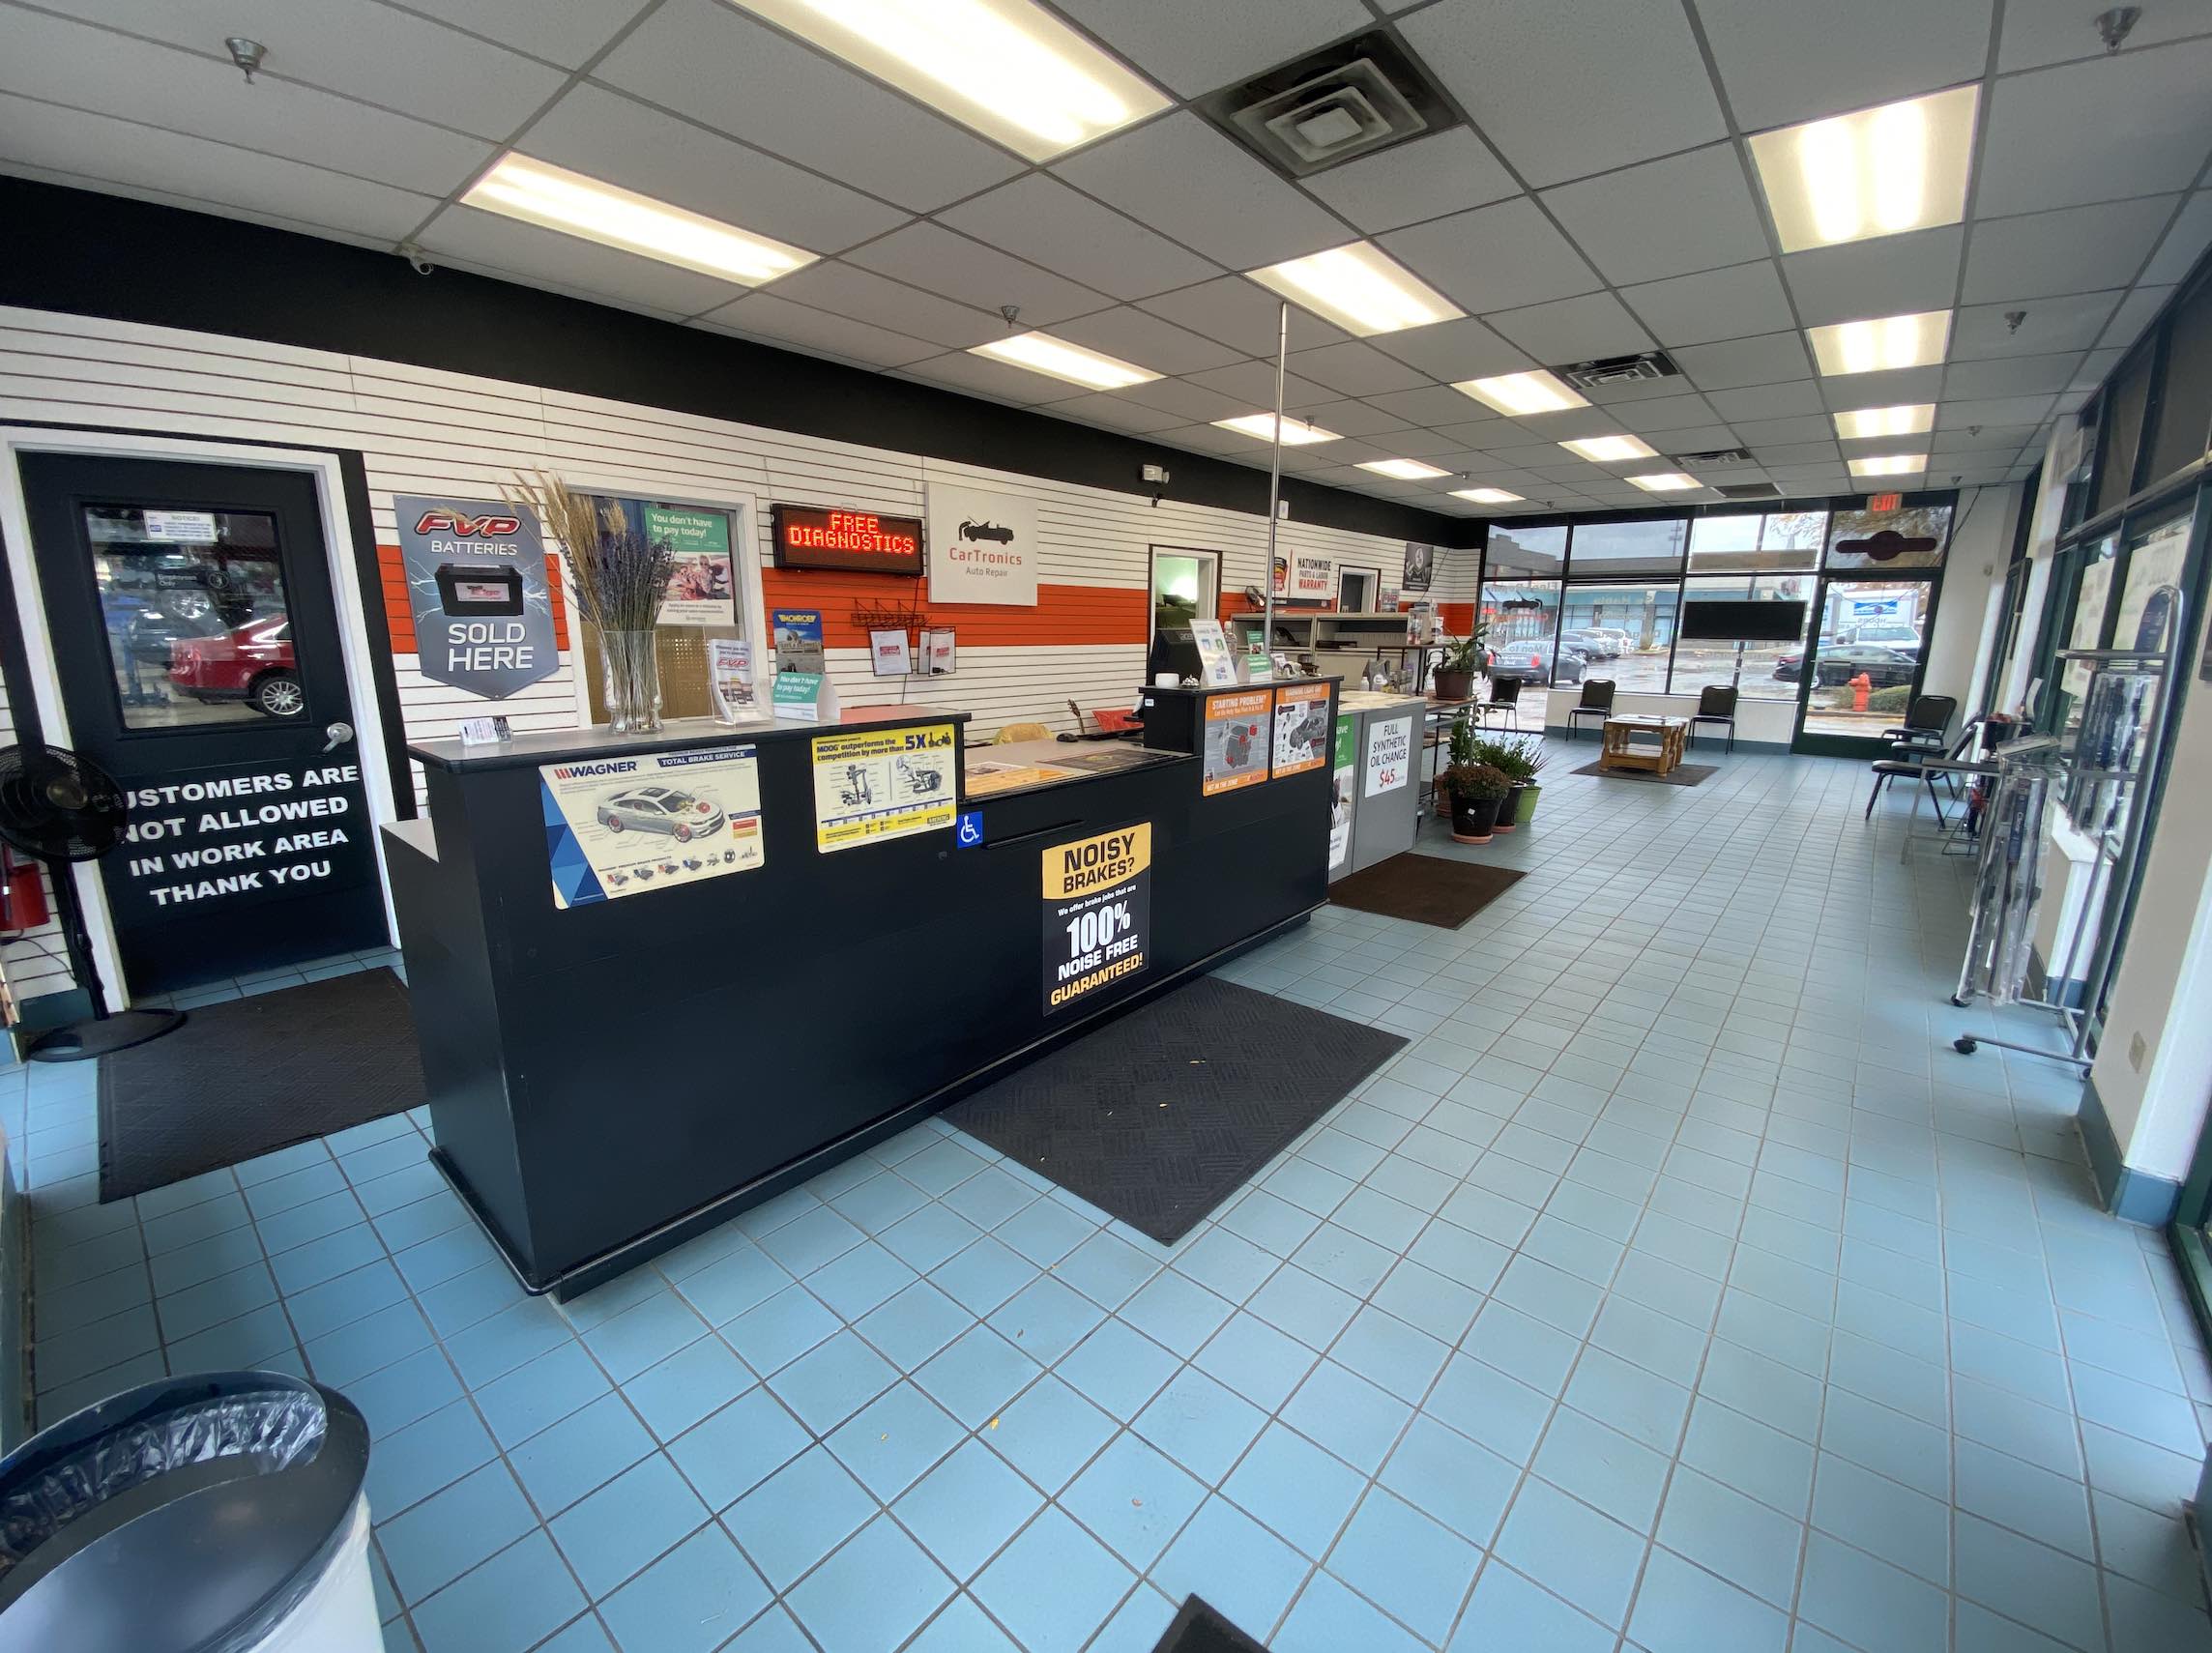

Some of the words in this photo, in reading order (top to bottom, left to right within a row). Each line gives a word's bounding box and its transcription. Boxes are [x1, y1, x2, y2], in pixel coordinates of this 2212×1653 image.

[1873, 494, 1900, 511] EXIT
[416, 511, 522, 537] FVP
[651, 513, 669, 523] You
[669, 514, 692, 525] don't
[693, 517, 713, 528] have
[830, 512, 879, 535] FREE
[652, 524, 663, 533] to
[663, 526, 680, 536] pay
[681, 526, 707, 538] today!
[788, 526, 915, 555] DIAGNOSTICS
[431, 540, 518, 556] BATTERIES
[949, 547, 1022, 566] CarTronics
[966, 566, 983, 576] Auto
[985, 568, 1008, 577] Repair
[1297, 557, 1331, 572] NATIONWIDE
[1298, 579, 1327, 592] WARRANTY
[778, 614, 817, 623] MONROE
[448, 623, 526, 645] SOLD
[1179, 632, 1194, 641] ace
[448, 646, 535, 672] HERE
[1212, 698, 1237, 710] STARTING
[1335, 725, 1349, 735] ave
[1383, 723, 1398, 737] FULL
[817, 743, 838, 753] MOOG
[840, 740, 884, 751] outperforms
[905, 734, 926, 751] 5X
[1373, 736, 1407, 753] SYNTHETIC
[817, 749, 861, 762] competition
[888, 744, 905, 753] than
[1370, 755, 1382, 768] OIL
[1382, 748, 1407, 765] CHANGE
[568, 761, 637, 778] WAGNER
[687, 754, 713, 763] BRAKE
[714, 751, 745, 761] SERVICE
[114, 772, 293, 809] USTOMERS
[303, 765, 360, 787] ARE
[1380, 768, 1395, 788] $45
[198, 797, 349, 833] ALLOWED
[129, 856, 164, 877] IN
[171, 841, 266, 869] WORK
[274, 828, 349, 854] AREA
[1064, 832, 1135, 873] NOISY
[150, 872, 263, 906] THANK
[268, 860, 332, 884] YOU
[1063, 856, 1135, 893] BRAKES?
[1058, 907, 1068, 916] We
[1069, 902, 1084, 913] offer
[1085, 895, 1101, 908] brake
[1102, 891, 1115, 903] jobs
[1115, 888, 1126, 897] that
[1066, 900, 1131, 958] 100%
[1058, 949, 1101, 981] NOISE
[1106, 934, 1139, 961] FREE
[1051, 951, 1144, 1006] GUARANTEED!
